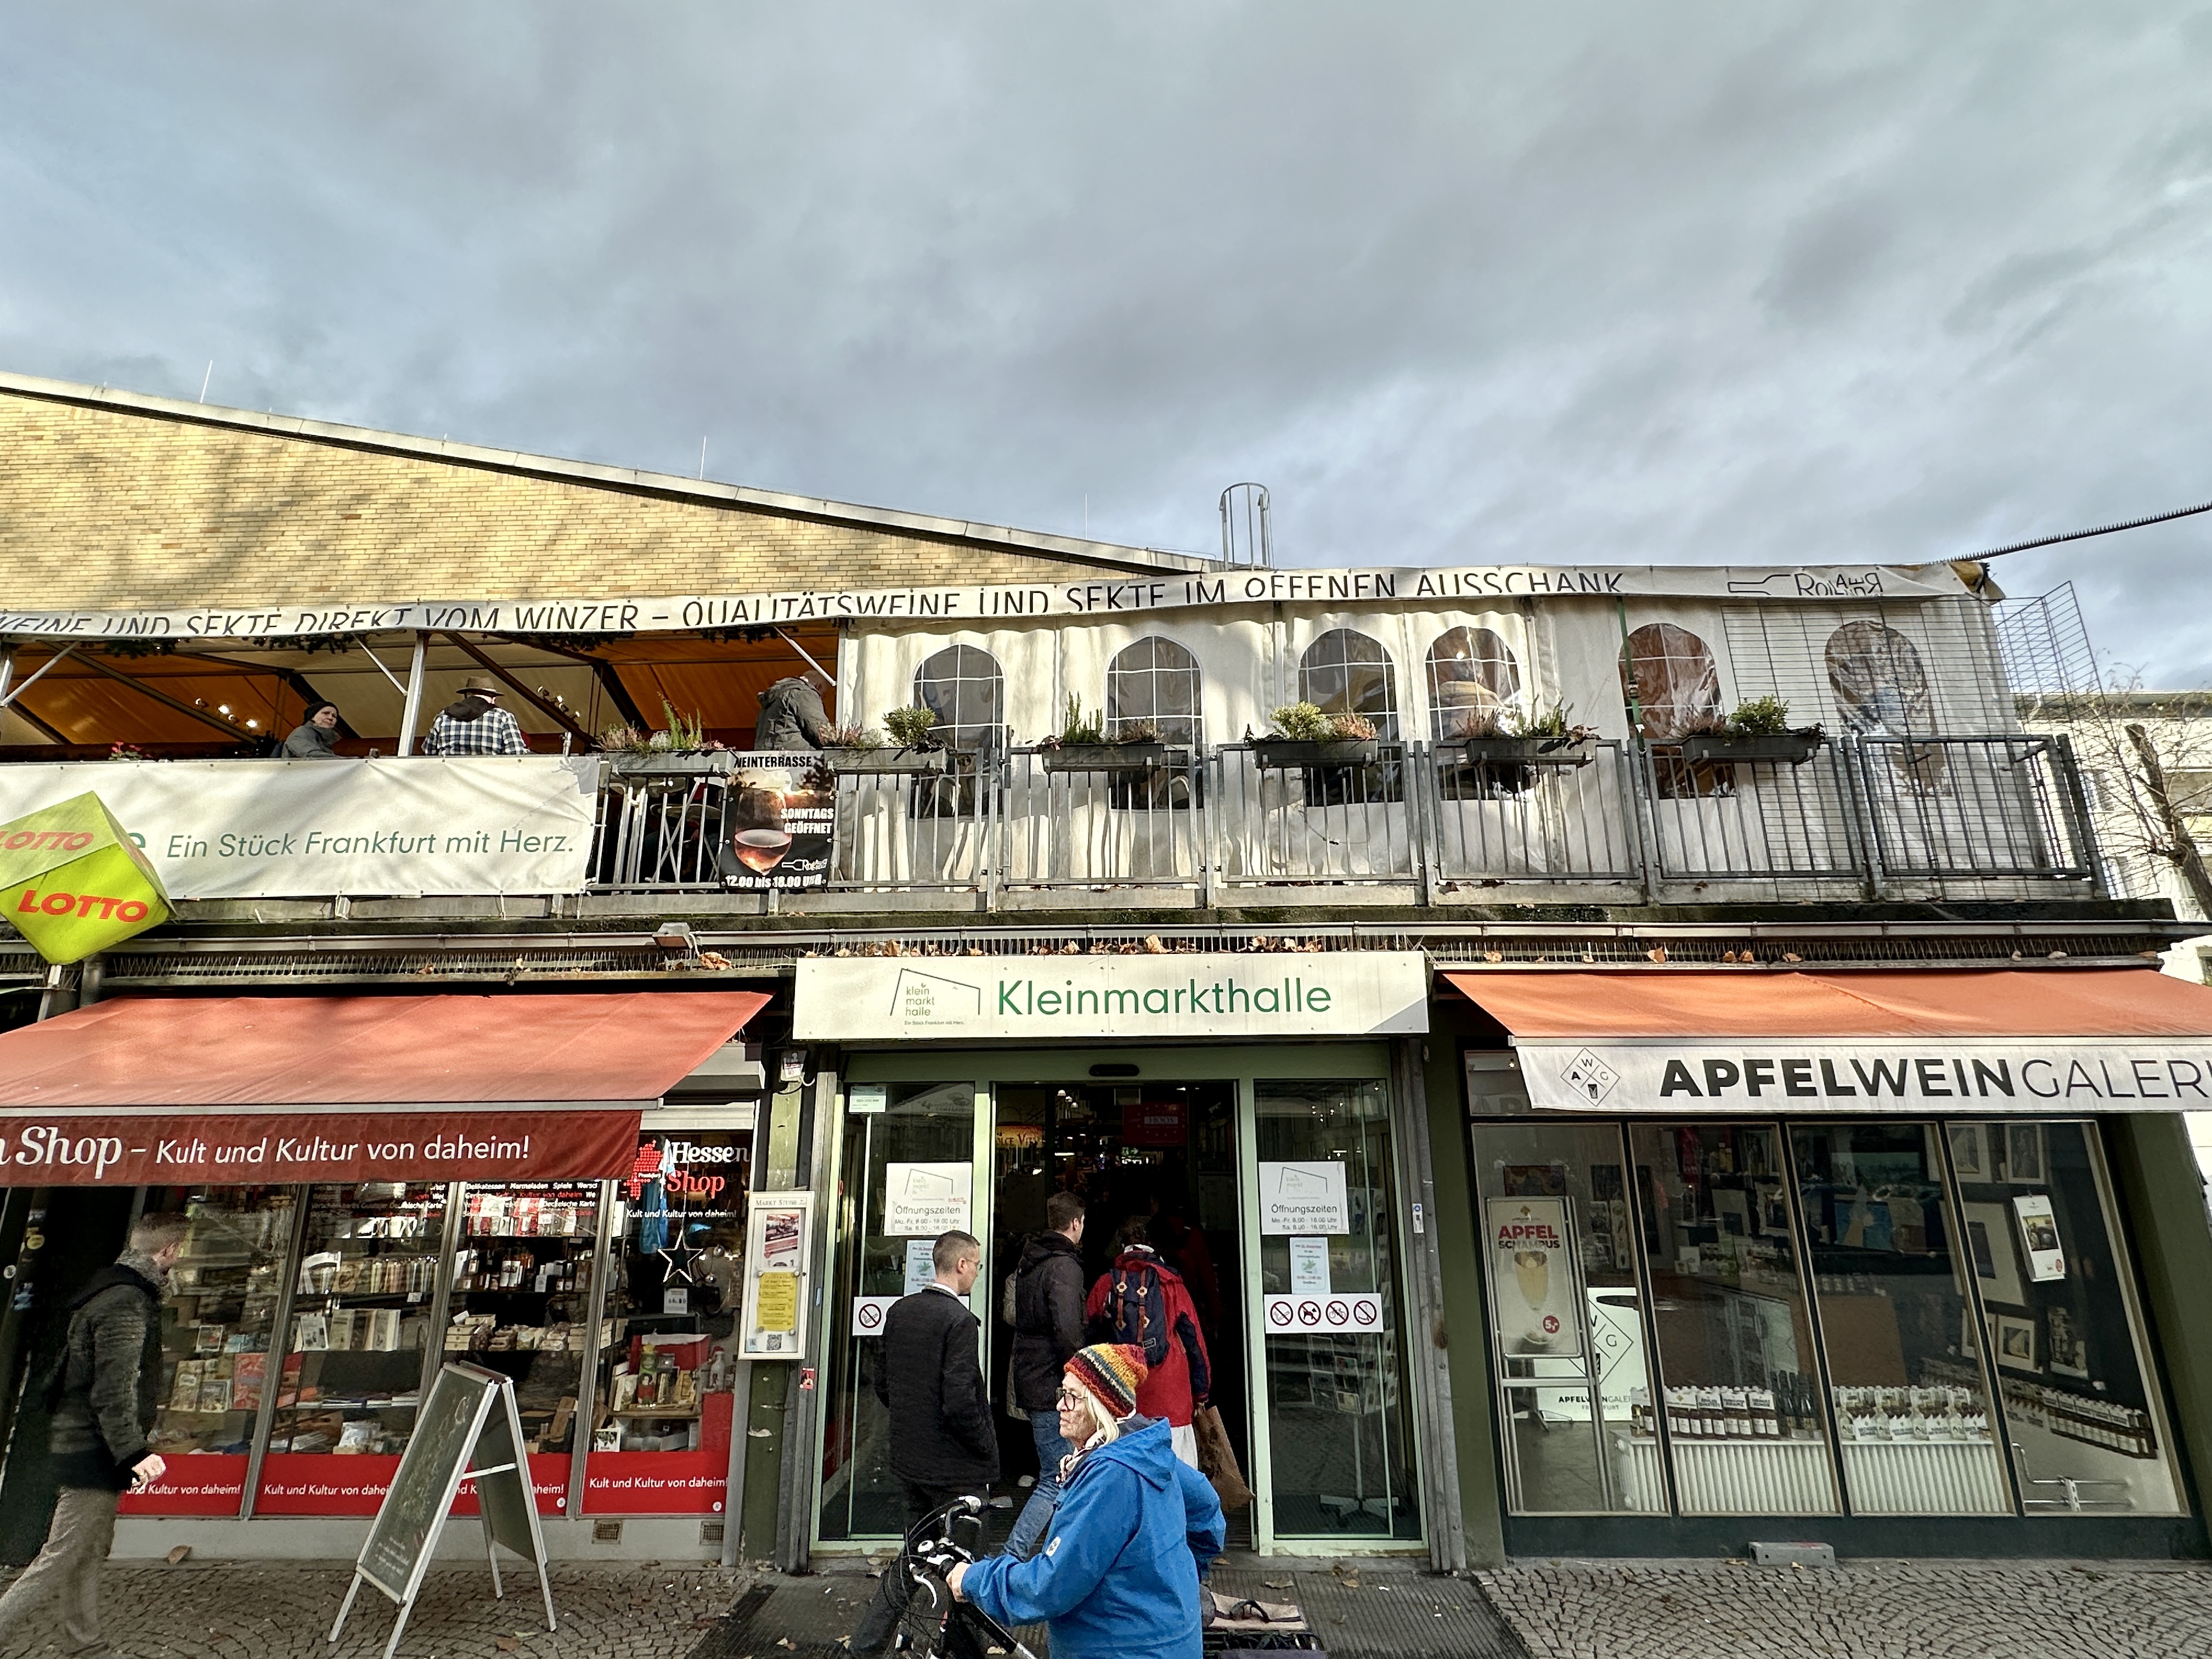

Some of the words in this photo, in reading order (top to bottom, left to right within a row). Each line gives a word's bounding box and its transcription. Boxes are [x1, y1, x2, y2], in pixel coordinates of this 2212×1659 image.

[101, 617, 170, 634] UND
[187, 614, 282, 635] SEKTE
[294, 608, 412, 633] DIREKT
[426, 607, 500, 629] VOM
[516, 605, 639, 630] WINZER
[979, 590, 1048, 614] UND
[1066, 583, 1165, 612] SEKTE
[1186, 579, 1225, 604] IM
[1245, 573, 1396, 598] OFFENEN
[1417, 572, 1623, 596] AUSSCHANK
[780, 808, 834, 820] SONNTAGS
[784, 821, 832, 834] GEÖFFNET
[167, 836, 208, 859] Ein
[218, 832, 297, 856] Stück
[304, 830, 436, 855] Frankfurt
[445, 829, 490, 854] mit
[500, 829, 574, 854] Herz.
[725, 876, 753, 887] 12.00
[754, 877, 771, 887] bis
[774, 876, 802, 887] 18.00
[18, 889, 149, 923] LOTTO
[906, 983, 929, 995] klein
[906, 996, 934, 1006] markt
[998, 977, 1332, 1015] Kleinmarkthalle
[905, 1007, 931, 1016] halle
[16, 1126, 122, 1180] Shop
[156, 1138, 206, 1164] Kult
[215, 1137, 268, 1163] und
[275, 1136, 358, 1162] Kultur
[366, 1143, 414, 1160] von
[424, 1135, 529, 1160] daheim!
[671, 1142, 751, 1163] Hessen
[667, 1170, 725, 1199] Shop
[627, 1210, 643, 1218] Kult
[645, 1210, 661, 1218] und
[662, 1210, 686, 1218] Kultur
[705, 1209, 737, 1218] daheim!
[895, 1205, 961, 1216] Öffnungszeiten
[1271, 1203, 1338, 1215] Öffnungszeiten
[1498, 1225, 1559, 1239] APFEL
[589, 1477, 609, 1488] Kult
[612, 1477, 631, 1488] und
[634, 1476, 665, 1488] Kultur
[667, 1479, 686, 1488] von
[689, 1476, 728, 1488] daheim!
[148, 1483, 178, 1494] Kultur
[180, 1486, 199, 1494] von
[201, 1483, 241, 1494] daheim!
[264, 1484, 284, 1495] Kult
[286, 1484, 306, 1495] und
[308, 1484, 338, 1495] Kultur
[341, 1486, 359, 1495] von
[361, 1484, 390, 1496] dahei
[456, 1484, 467, 1494] nd
[533, 1483, 564, 1494] aheim!
